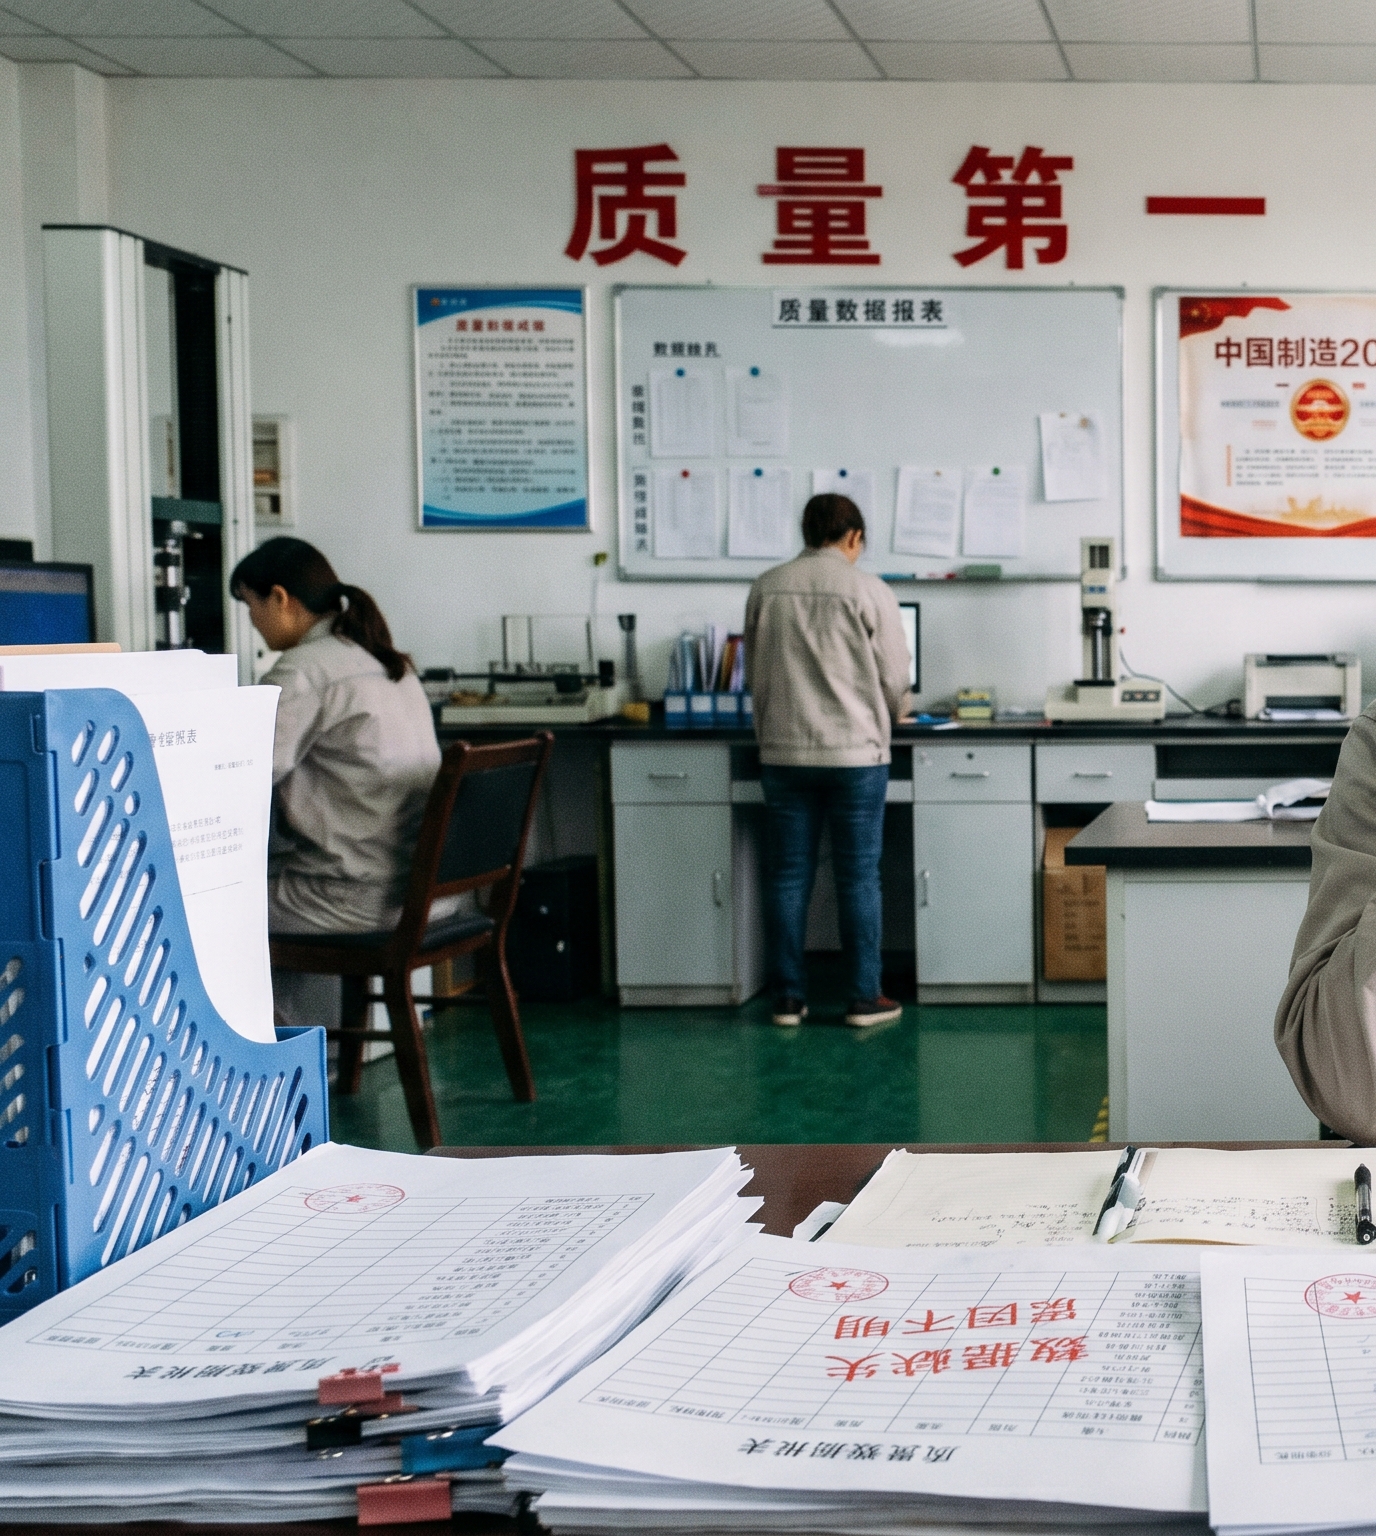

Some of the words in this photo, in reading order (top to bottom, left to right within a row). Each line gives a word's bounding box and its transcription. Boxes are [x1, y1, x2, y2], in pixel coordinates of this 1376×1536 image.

[564, 143, 1266, 270] 质量第一
[778, 298, 943, 323] 质量数据报表
